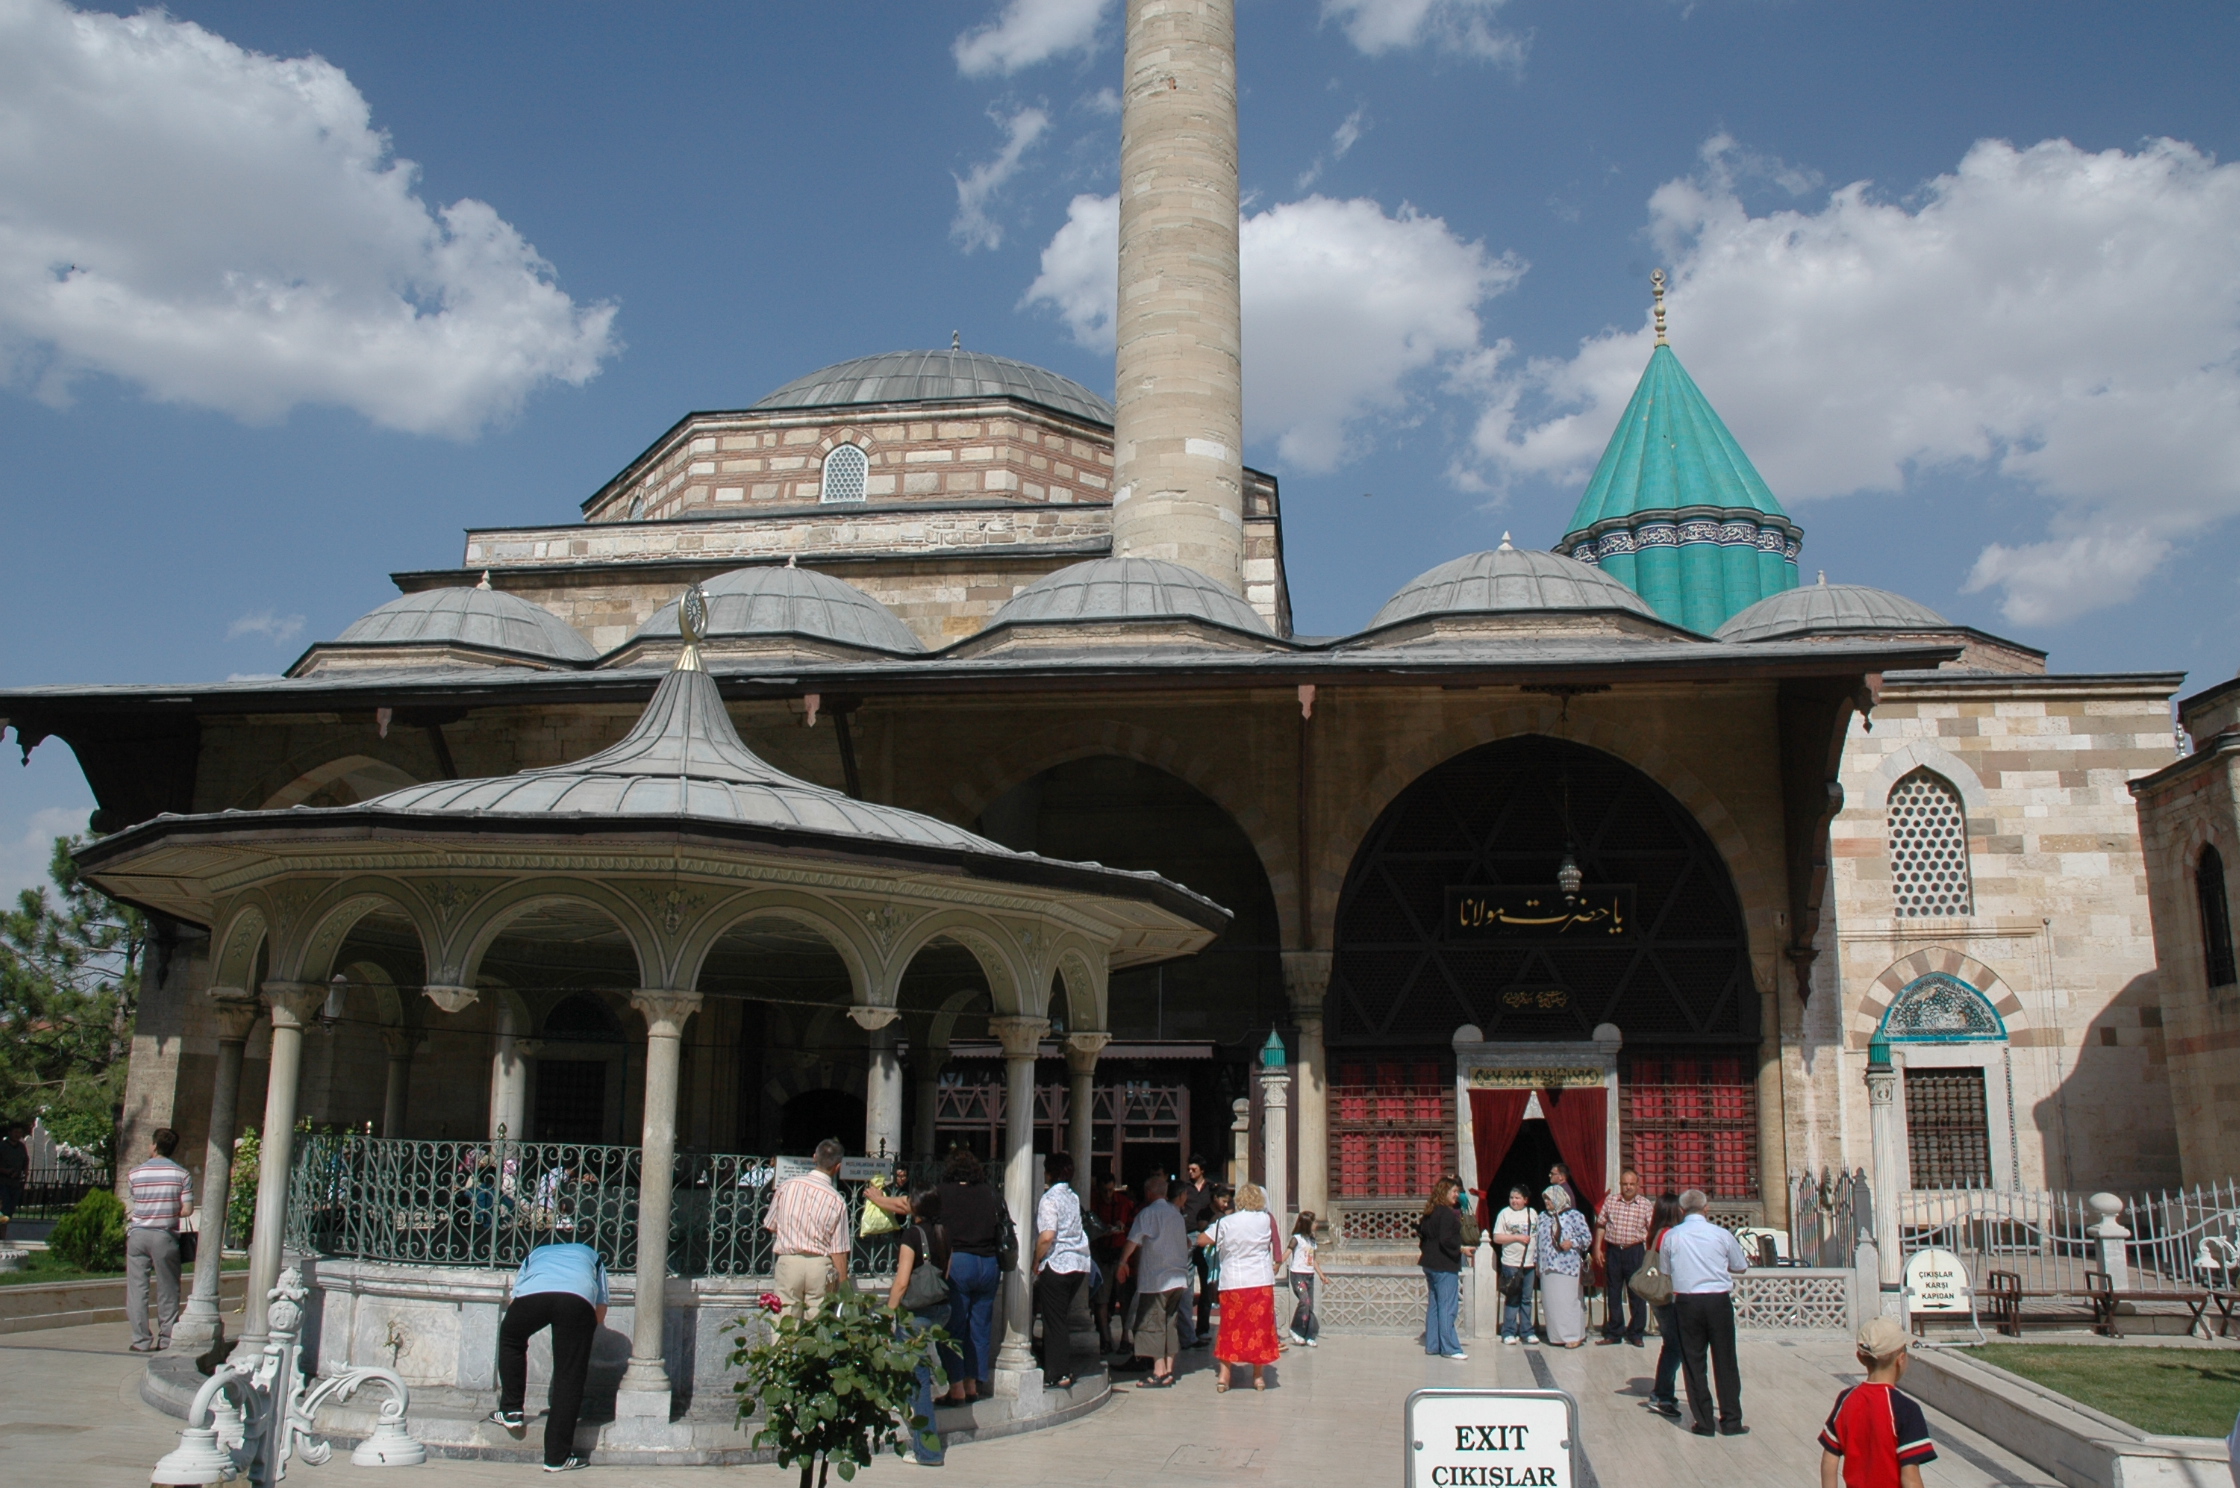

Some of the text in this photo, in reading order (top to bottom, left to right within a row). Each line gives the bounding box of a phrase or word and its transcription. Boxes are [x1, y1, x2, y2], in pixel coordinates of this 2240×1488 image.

[1460, 896, 1623, 934] يا حضرت مولانا
[1918, 1271, 1954, 1279] ÇIKIŞLAR
[1925, 1282, 1949, 1290] KARŞI
[1921, 1292, 1955, 1300] KAPIDAN
[1455, 1425, 1529, 1451] EXIT
[1431, 1465, 1558, 1488] ÇIKIŞLAR
